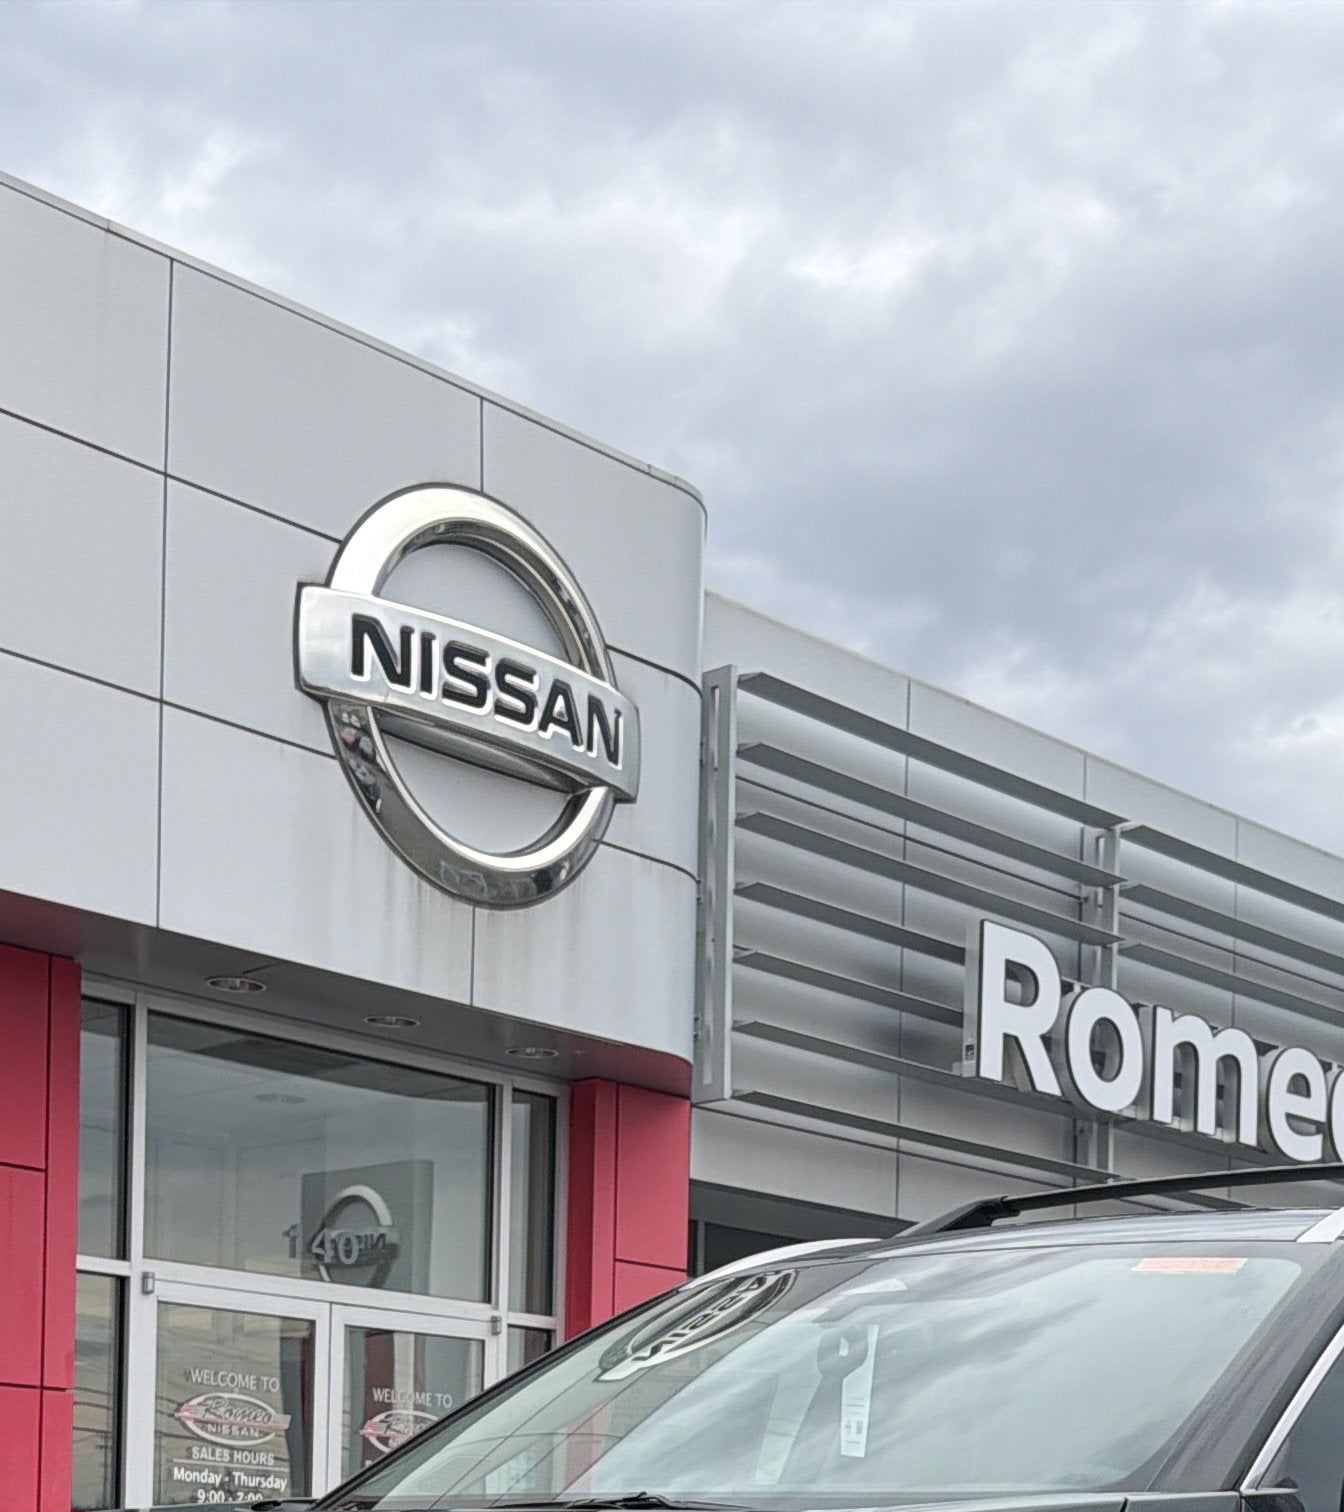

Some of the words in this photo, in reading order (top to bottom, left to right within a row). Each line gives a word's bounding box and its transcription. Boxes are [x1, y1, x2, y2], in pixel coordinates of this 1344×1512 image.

[350, 612, 623, 770] NISSAN
[190, 1368, 258, 1391] WELCOME
[261, 1376, 281, 1392] TO
[372, 1387, 434, 1407] WELCOME
[436, 1393, 454, 1409] TO
[196, 1396, 273, 1425] Romeo
[207, 1424, 260, 1438] NISSAN
[191, 1446, 230, 1462] SALES
[233, 1450, 275, 1466] HOURS
[173, 1466, 222, 1487] Monday
[232, 1471, 288, 1492] Thursday
